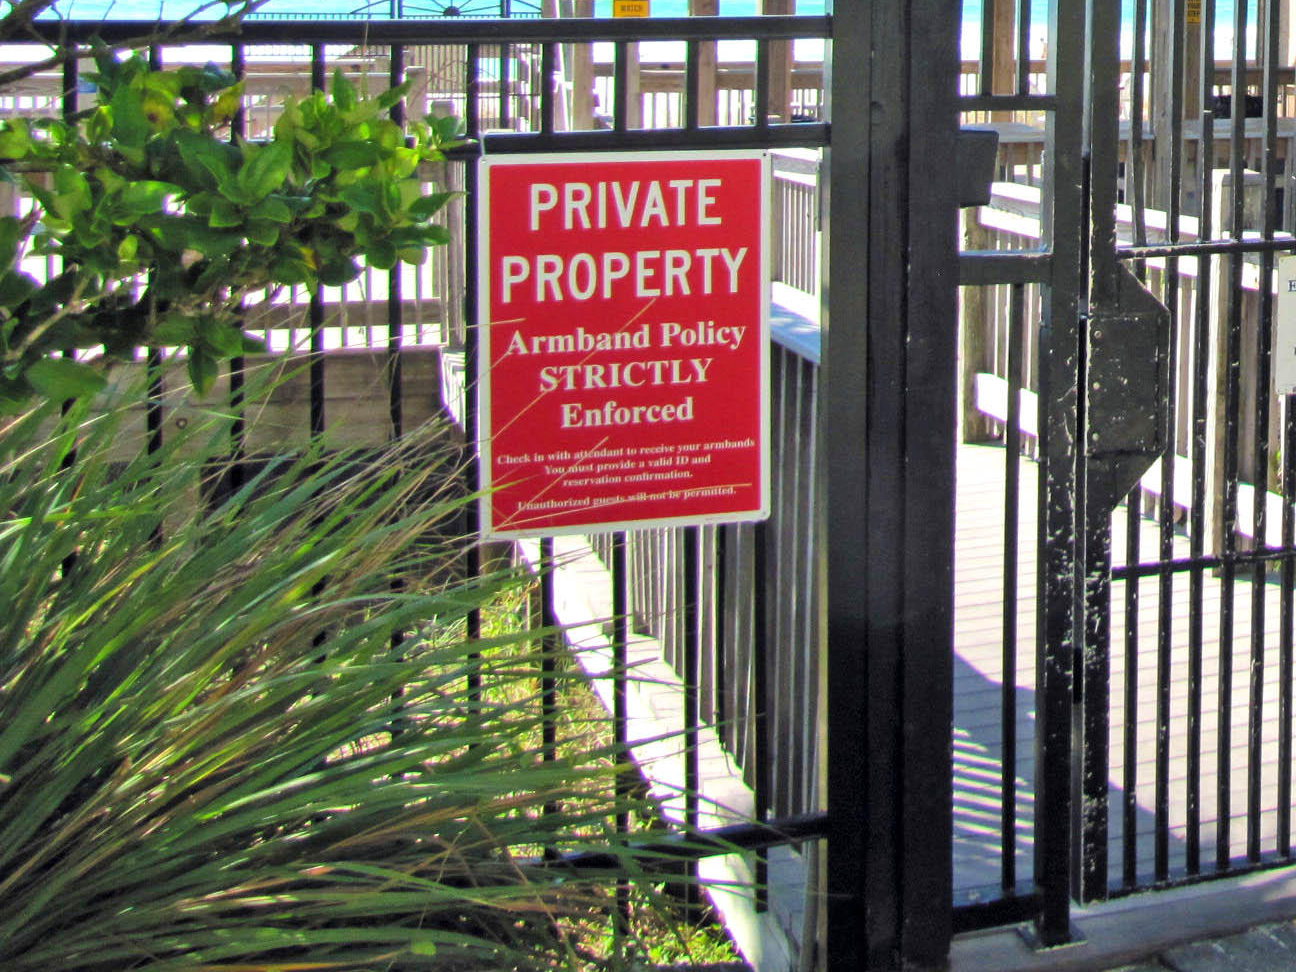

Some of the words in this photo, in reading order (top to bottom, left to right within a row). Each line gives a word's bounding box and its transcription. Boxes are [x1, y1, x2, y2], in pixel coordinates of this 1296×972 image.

[530, 178, 722, 231] PRIVATE
[501, 247, 749, 304] PROPERTY
[507, 324, 651, 356] Armband
[659, 321, 746, 349] Policy
[539, 357, 714, 392] STRICTLY
[560, 397, 695, 429] Enforced
[497, 454, 531, 465] Check
[534, 452, 545, 462] in
[548, 450, 571, 461] with
[574, 447, 624, 460] attendant
[626, 446, 637, 456] to
[640, 444, 675, 455] receive
[677, 443, 701, 454] your
[703, 437, 755, 450] armbands
[544, 465, 566, 475] You
[568, 464, 594, 474] must
[597, 459, 636, 473] provide
[638, 460, 645, 468] a
[648, 456, 673, 467] valid
[675, 455, 689, 465] ID
[691, 454, 712, 464] and
[562, 474, 622, 487] reservation
[624, 470, 694, 483] confirmation.
[517, 497, 590, 511] Unauthorized
[592, 494, 625, 508] guests
[628, 491, 647, 502] will
[649, 491, 666, 501] not
[668, 489, 681, 499] be
[683, 485, 737, 500] permitted.
